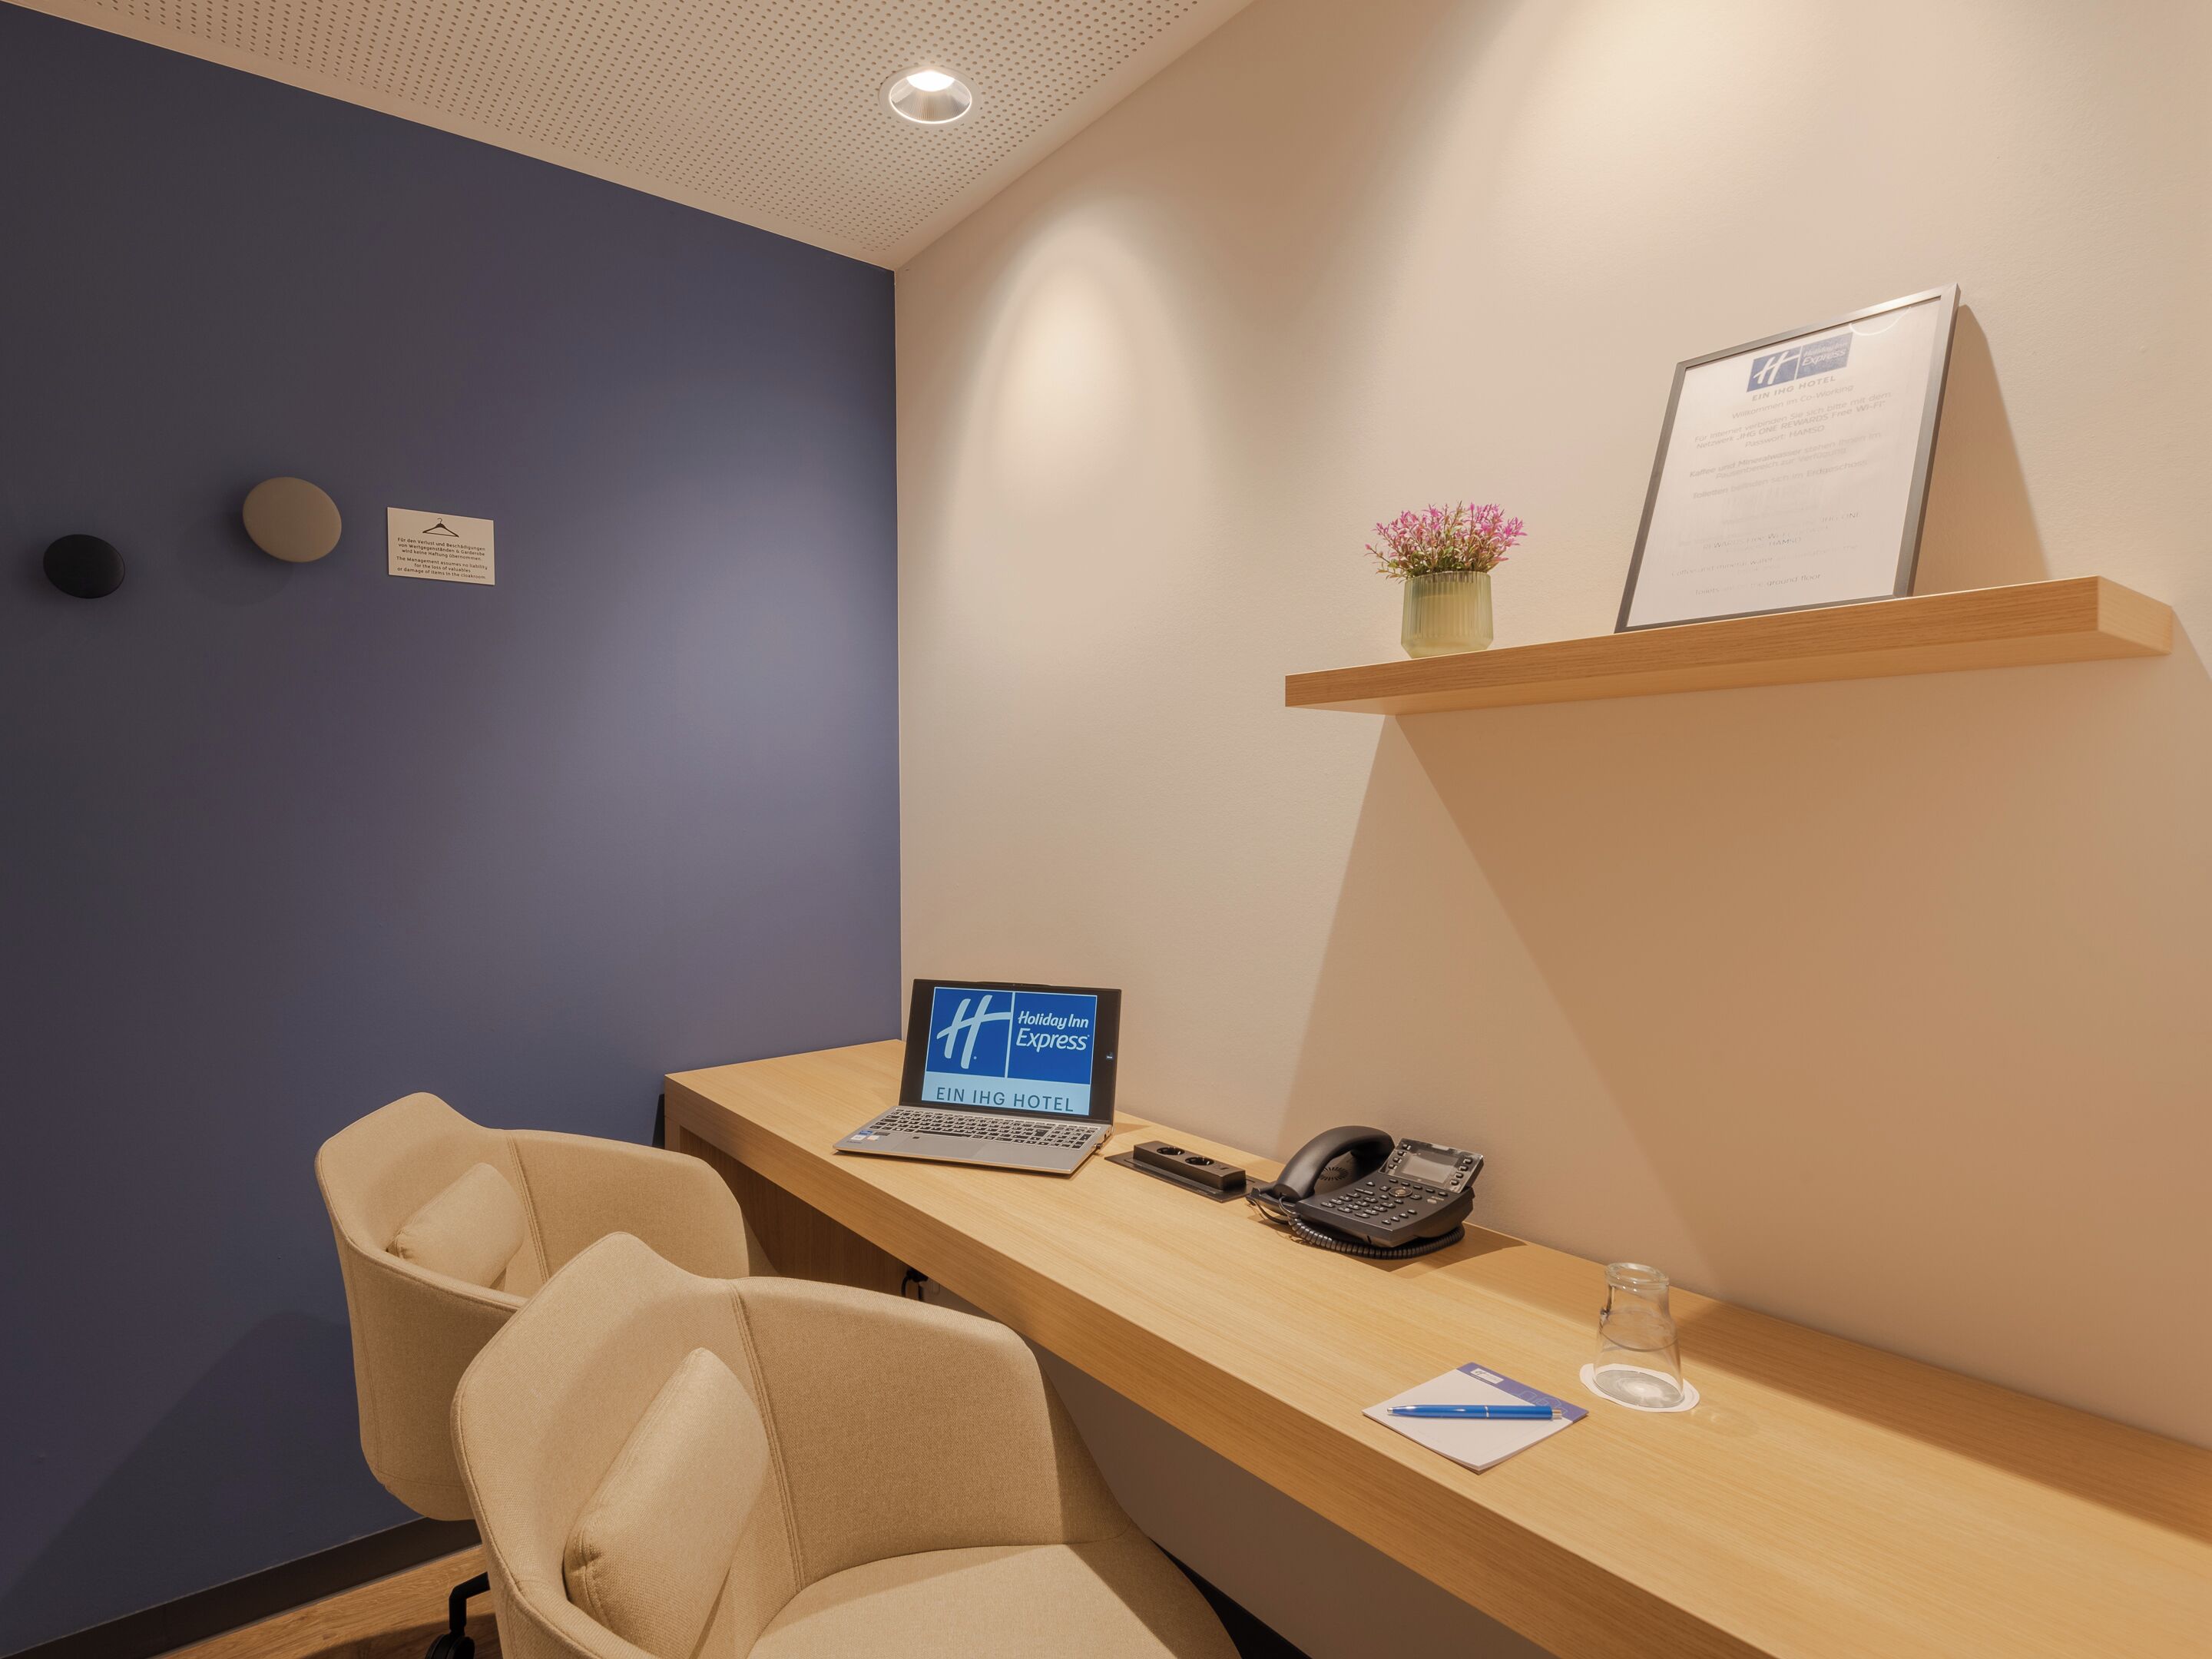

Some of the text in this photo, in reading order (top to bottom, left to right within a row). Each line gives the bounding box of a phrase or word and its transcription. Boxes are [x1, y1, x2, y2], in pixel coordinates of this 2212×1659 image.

[1802, 349, 1846, 366] Express
[1752, 376, 1836, 401] EIN IHG HOTEL
[1732, 402, 1783, 419] Willkommen
[1800, 385, 1854, 402] Co-Working
[1744, 416, 1786, 430] verbinden
[1790, 411, 1803, 419] Sie
[1806, 407, 1824, 416] sich
[1827, 402, 1847, 411] bitte
[1850, 397, 1866, 406] mit
[1869, 392, 1892, 402] dem
[1696, 436, 1734, 449] Netzwerk
[1759, 426, 1777, 434] ONE
[1781, 413, 1830, 429] REWARDS
[1831, 408, 1853, 419] Free
[1689, 468, 1716, 477] Kaffee
[1719, 462, 1735, 471] und
[1738, 449, 1801, 466] Mineralwasser
[1804, 442, 1835, 452] stehen
[1715, 462, 1778, 478] Pausenbereich
[1693, 488, 1728, 498] Toiletten
[1771, 475, 1790, 483] sich
[409, 544, 454, 553] Wertgegenständen
[446, 542, 485, 551] Beschädigungen
[407, 557, 439, 565] Management
[1766, 576, 1798, 587] ground
[1018, 1011, 1088, 1029] Holiday Inn
[1015, 1028, 1088, 1052] Express
[936, 1087, 1074, 1112] EIN IHG HOTEL
